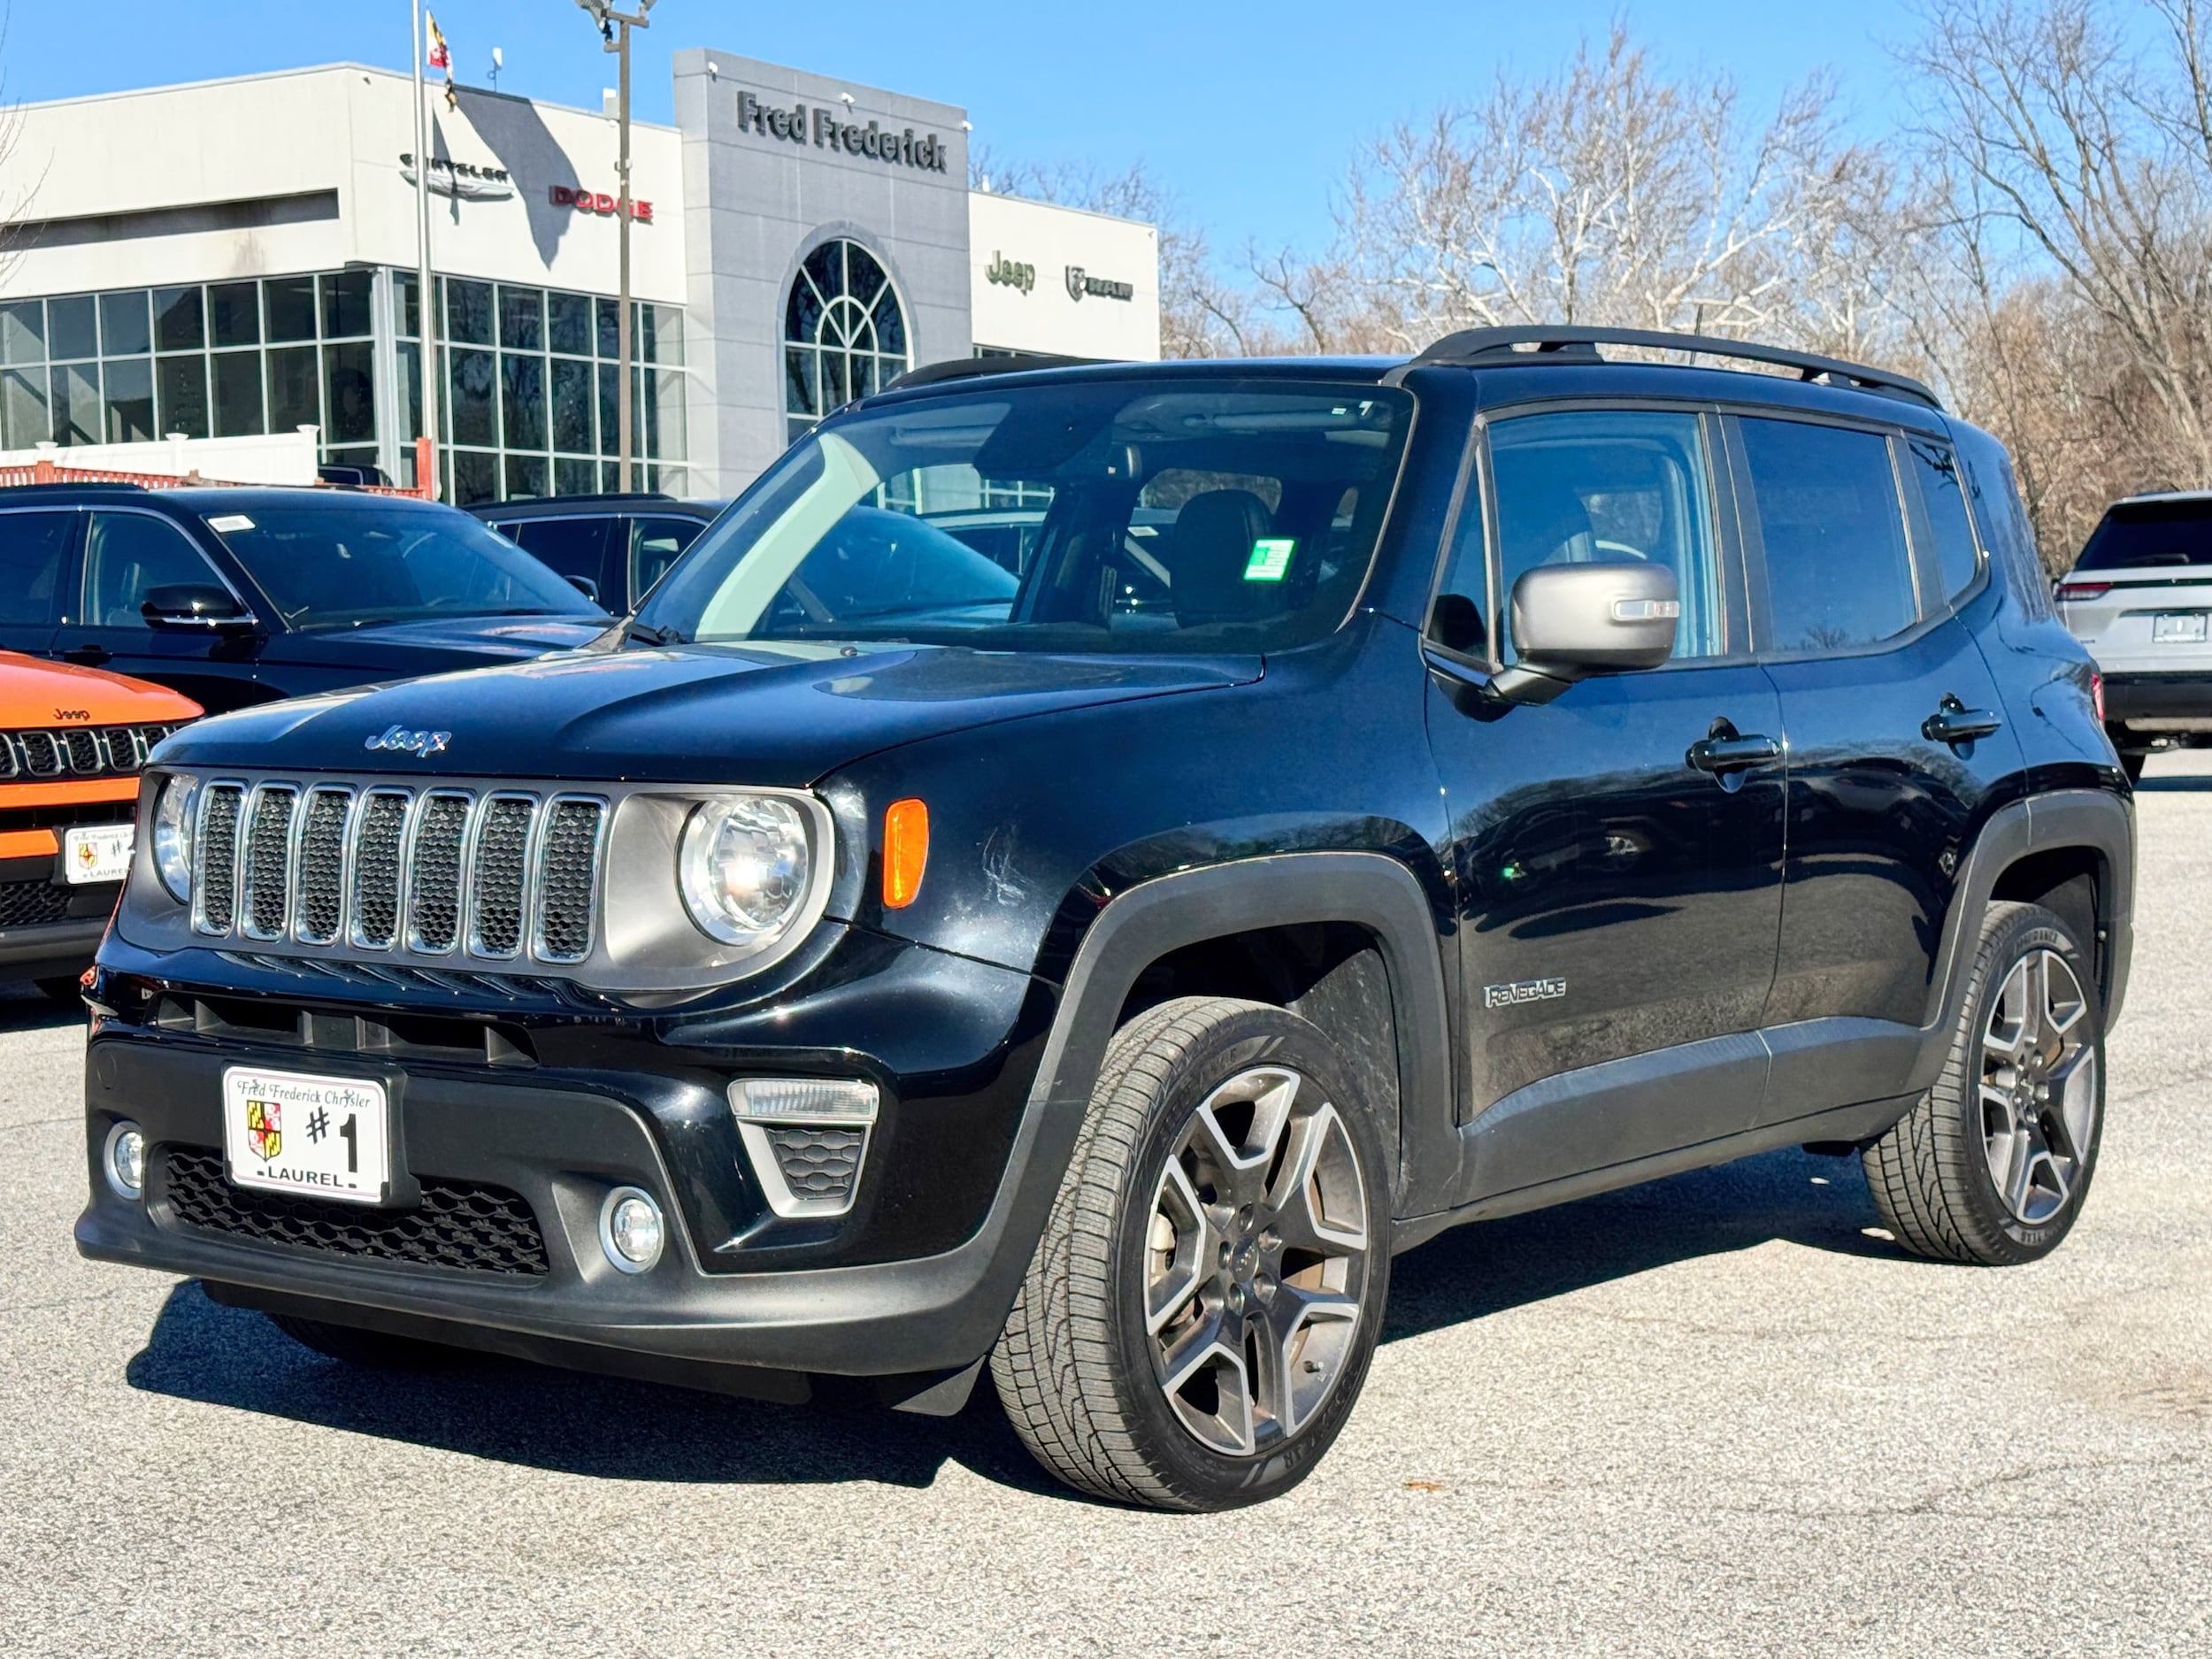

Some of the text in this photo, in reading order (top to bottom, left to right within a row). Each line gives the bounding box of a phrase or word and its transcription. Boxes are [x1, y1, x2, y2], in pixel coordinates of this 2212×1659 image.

[737, 90, 947, 173] Fred Frederick
[400, 153, 509, 184] CRYSLER
[985, 250, 1035, 296] Jeep
[52, 708, 90, 721] Jeep
[365, 725, 452, 757] Jeep
[1484, 977, 1566, 1008] RENEGADE
[237, 1080, 371, 1108] Fred Frederick Chrysler
[268, 1166, 344, 1187] LAUREL
